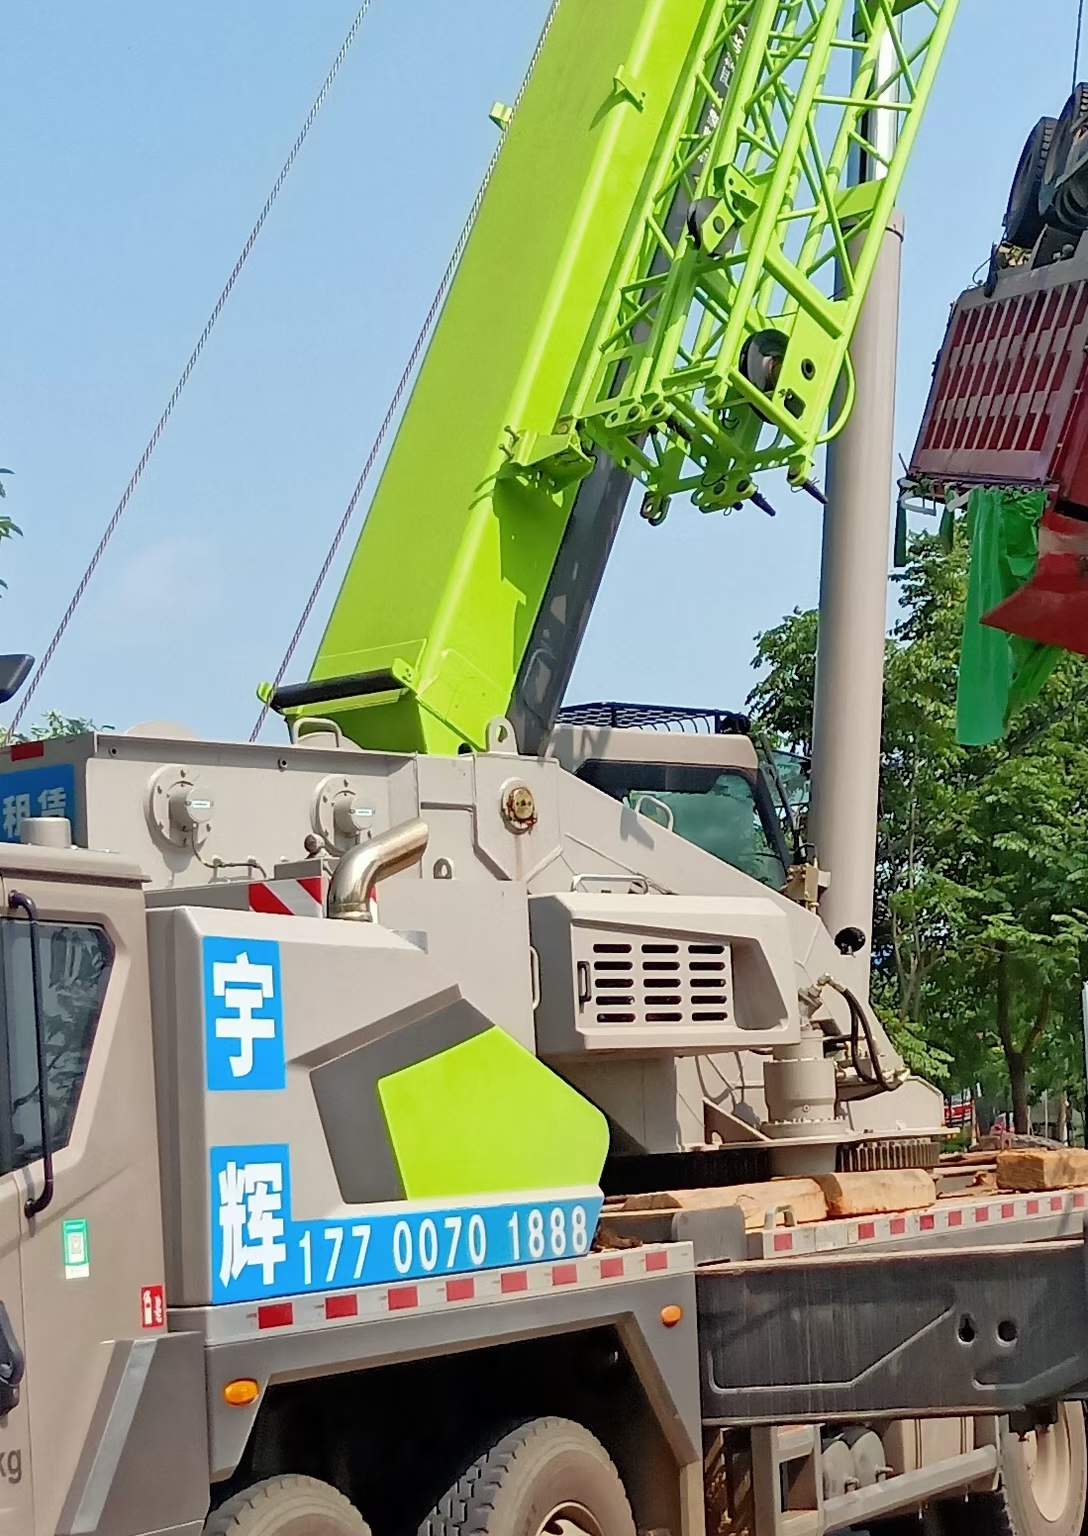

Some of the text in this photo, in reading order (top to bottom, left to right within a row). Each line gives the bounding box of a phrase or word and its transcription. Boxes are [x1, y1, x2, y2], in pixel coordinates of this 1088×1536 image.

[300, 1203, 588, 1284] 177 0070 1888
